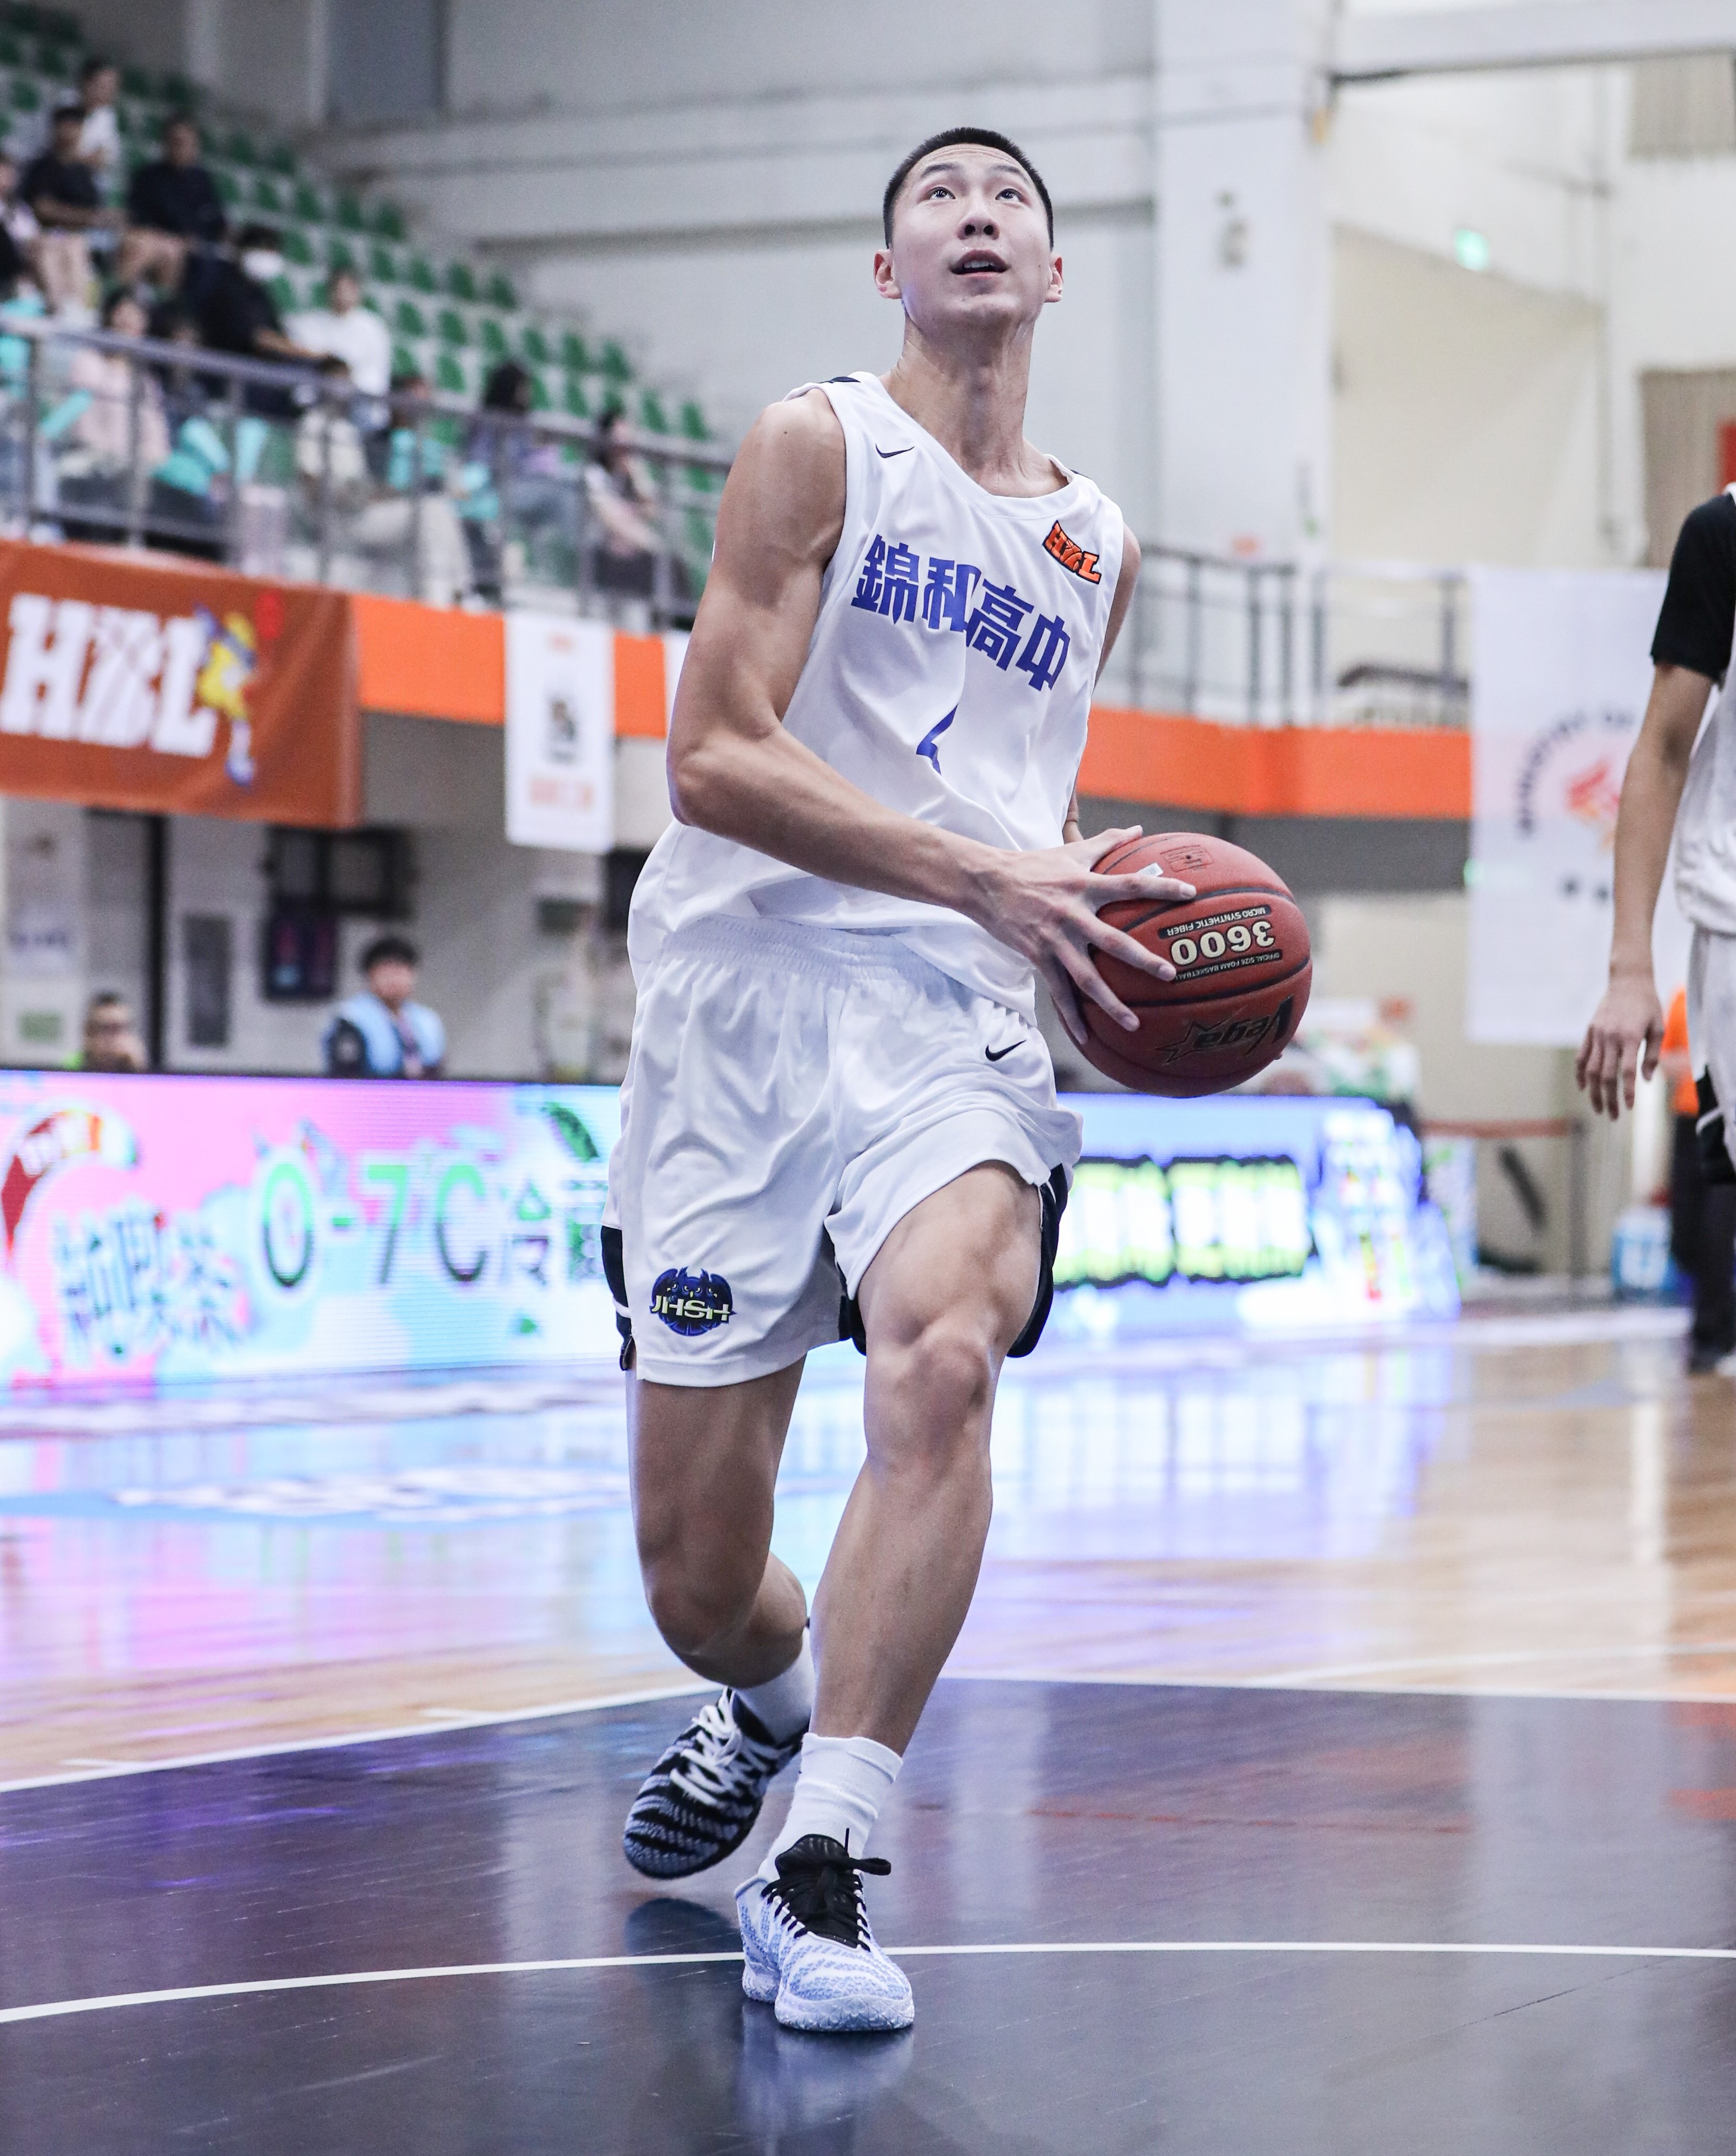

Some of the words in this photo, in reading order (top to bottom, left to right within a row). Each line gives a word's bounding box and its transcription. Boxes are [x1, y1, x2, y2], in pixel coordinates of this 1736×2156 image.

[851, 534, 1071, 692] 錦和高中
[1, 592, 218, 758] HBL
[1242, 907, 1265, 918] MICRO
[1196, 913, 1242, 929] SYNTHETIC
[1167, 923, 1194, 936] FIBER
[1171, 920, 1275, 965] 3600
[1257, 952, 1280, 962] OFFICIAL
[1220, 960, 1240, 971] FOAM
[652, 1295, 730, 1321] JHSH
